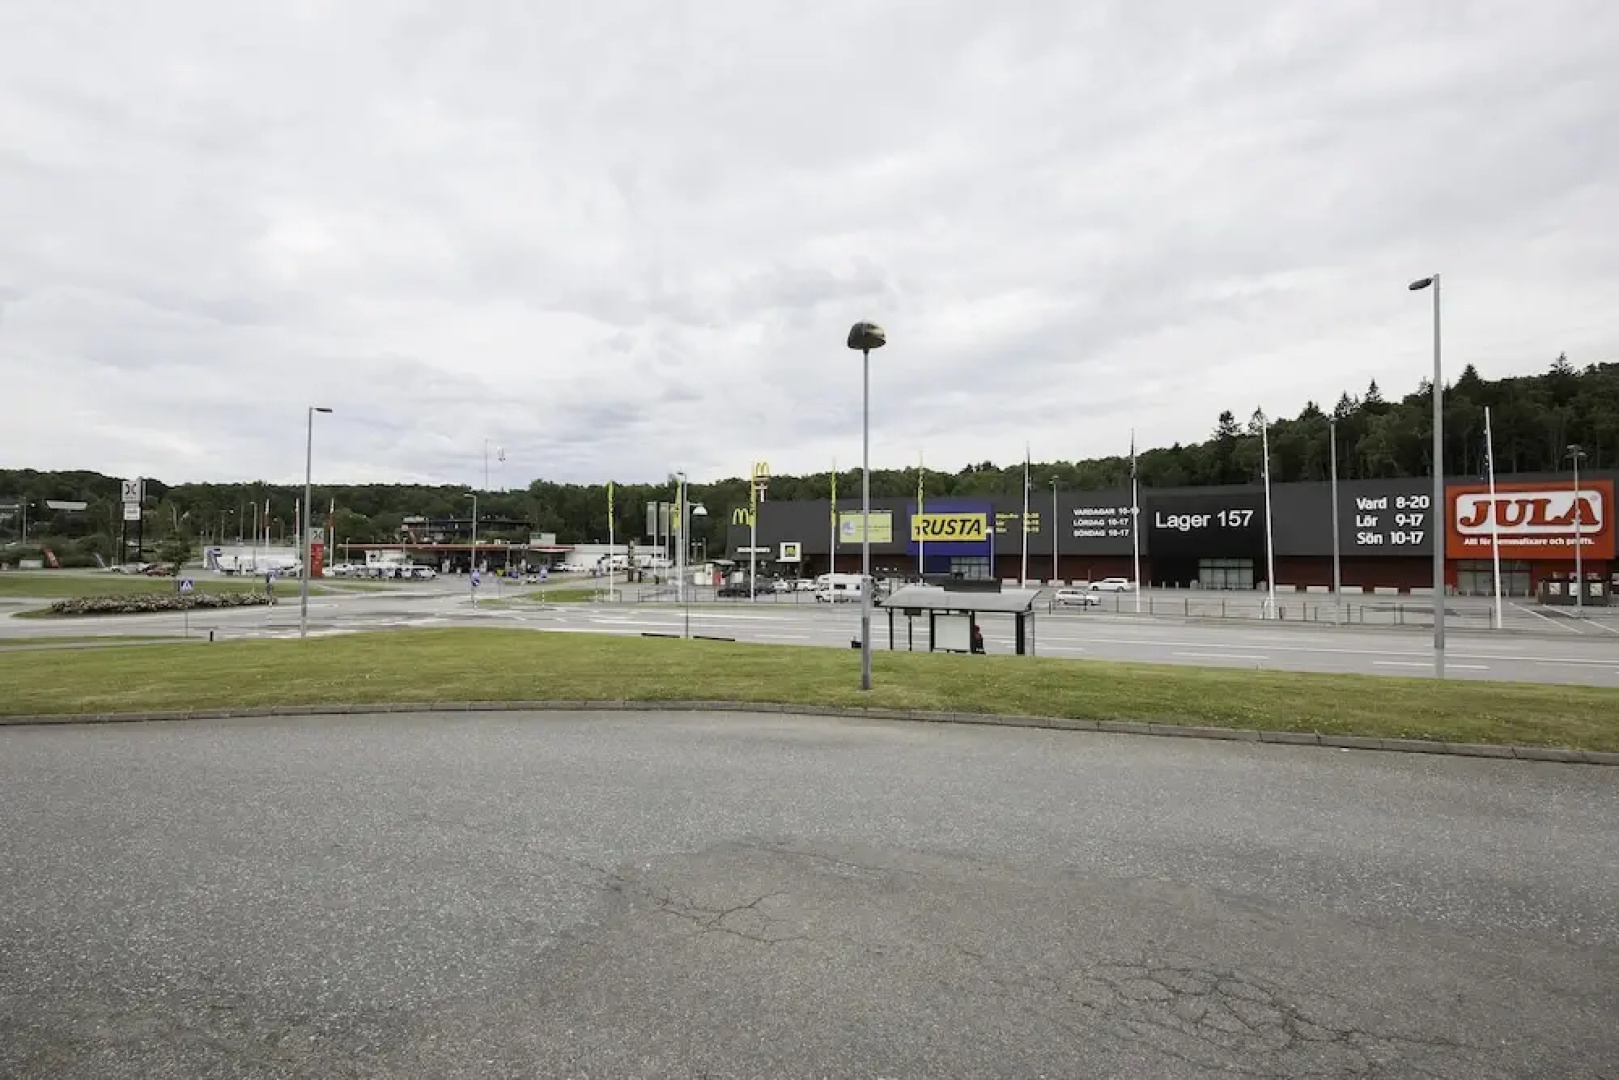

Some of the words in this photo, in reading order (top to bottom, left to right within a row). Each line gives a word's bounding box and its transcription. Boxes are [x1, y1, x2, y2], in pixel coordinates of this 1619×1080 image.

[1356, 497, 1387, 510] Vard
[1396, 496, 1430, 509] 8-20
[1073, 507, 1115, 516] VARDAGAR
[1460, 497, 1600, 526] JULA
[915, 519, 981, 535] RUSTA
[1073, 518, 1105, 527] LÖRDAG
[1108, 517, 1129, 526] 10-17
[1155, 511, 1212, 532] Lager
[1217, 509, 1254, 527] 157
[1356, 514, 1379, 527] Lör
[1395, 513, 1424, 527] 9-17
[1073, 528, 1106, 537] SÖNDAG
[1108, 529, 1129, 537] 10-17
[1356, 530, 1384, 545] Sön
[1390, 530, 1424, 545] 10-17
[1549, 537, 1564, 545] och
[1566, 537, 1595, 547] prffs.
